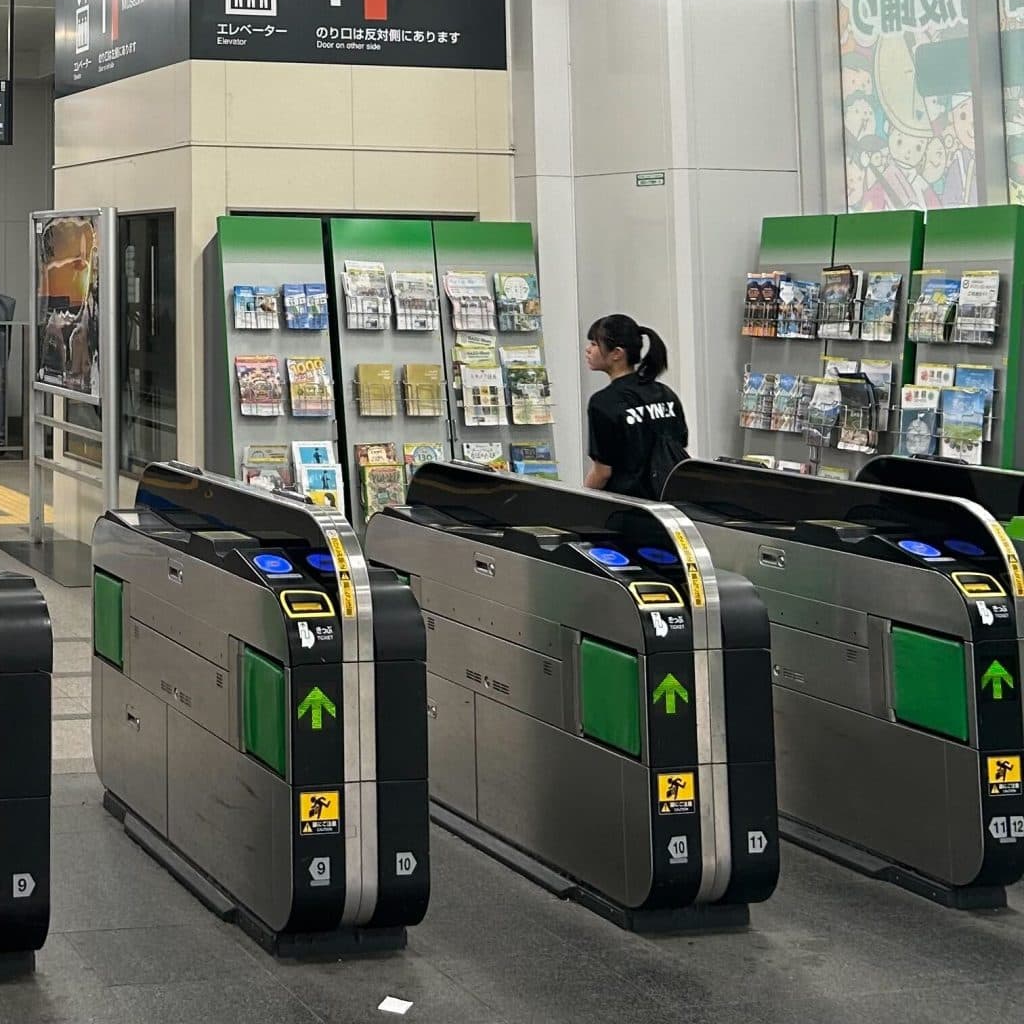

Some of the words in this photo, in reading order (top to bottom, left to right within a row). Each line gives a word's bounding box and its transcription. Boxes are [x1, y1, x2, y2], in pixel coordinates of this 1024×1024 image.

[217, 24, 287, 37] エレベーター
[316, 26, 461, 45] のり口は反対側にあります
[217, 37, 247, 46] Elevator
[316, 41, 334, 49] Door
[346, 42, 364, 50] other
[366, 43, 381, 51] side
[993, 822, 1005, 834] 11
[1012, 820, 1024, 833] 12
[673, 841, 685, 854] 10
[750, 835, 763, 848] 11
[317, 862, 325, 875] 9
[399, 858, 411, 871] 10
[18, 878, 27, 892] 9
